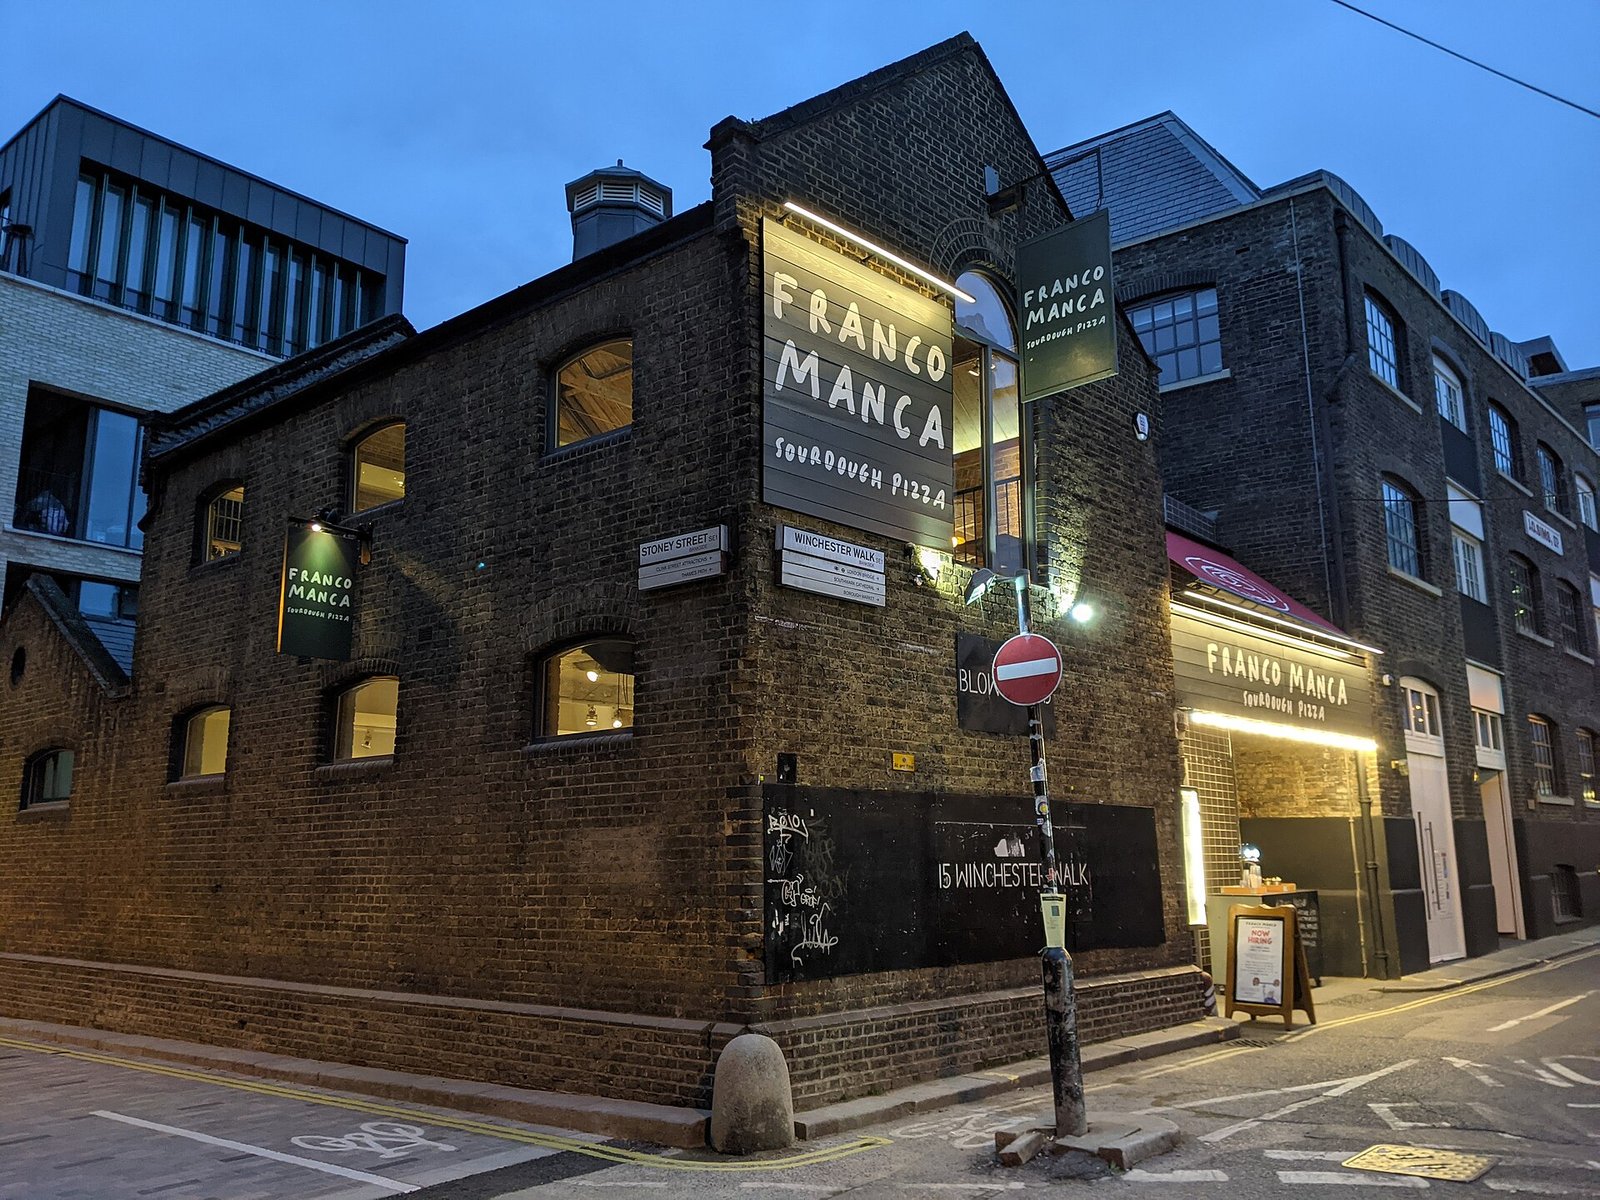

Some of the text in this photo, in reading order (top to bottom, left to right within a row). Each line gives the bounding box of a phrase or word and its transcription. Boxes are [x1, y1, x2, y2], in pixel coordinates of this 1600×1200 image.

[1024, 265, 1104, 308] FRANCO
[1026, 288, 1105, 331] MANCA
[773, 271, 947, 382] FRANCO
[1026, 315, 1106, 350] SOURDOUGH PIZZA
[774, 338, 945, 450] MANCA
[775, 436, 947, 511] SOURDOUGH PIZZA
[641, 533, 718, 556] STONEY STREET SE1
[794, 532, 852, 557] WINCHESTER
[853, 548, 876, 562] WALK
[288, 568, 352, 589] FRANCO
[288, 584, 350, 608] MANCA
[287, 606, 350, 622] SOURDOUGH PIZZA
[1207, 643, 1348, 706] FRANCO MANCA
[1242, 690, 1326, 722] SOURDOUGH PIZZA
[938, 862, 952, 888] 15
[1248, 936, 1272, 945] HIRING
